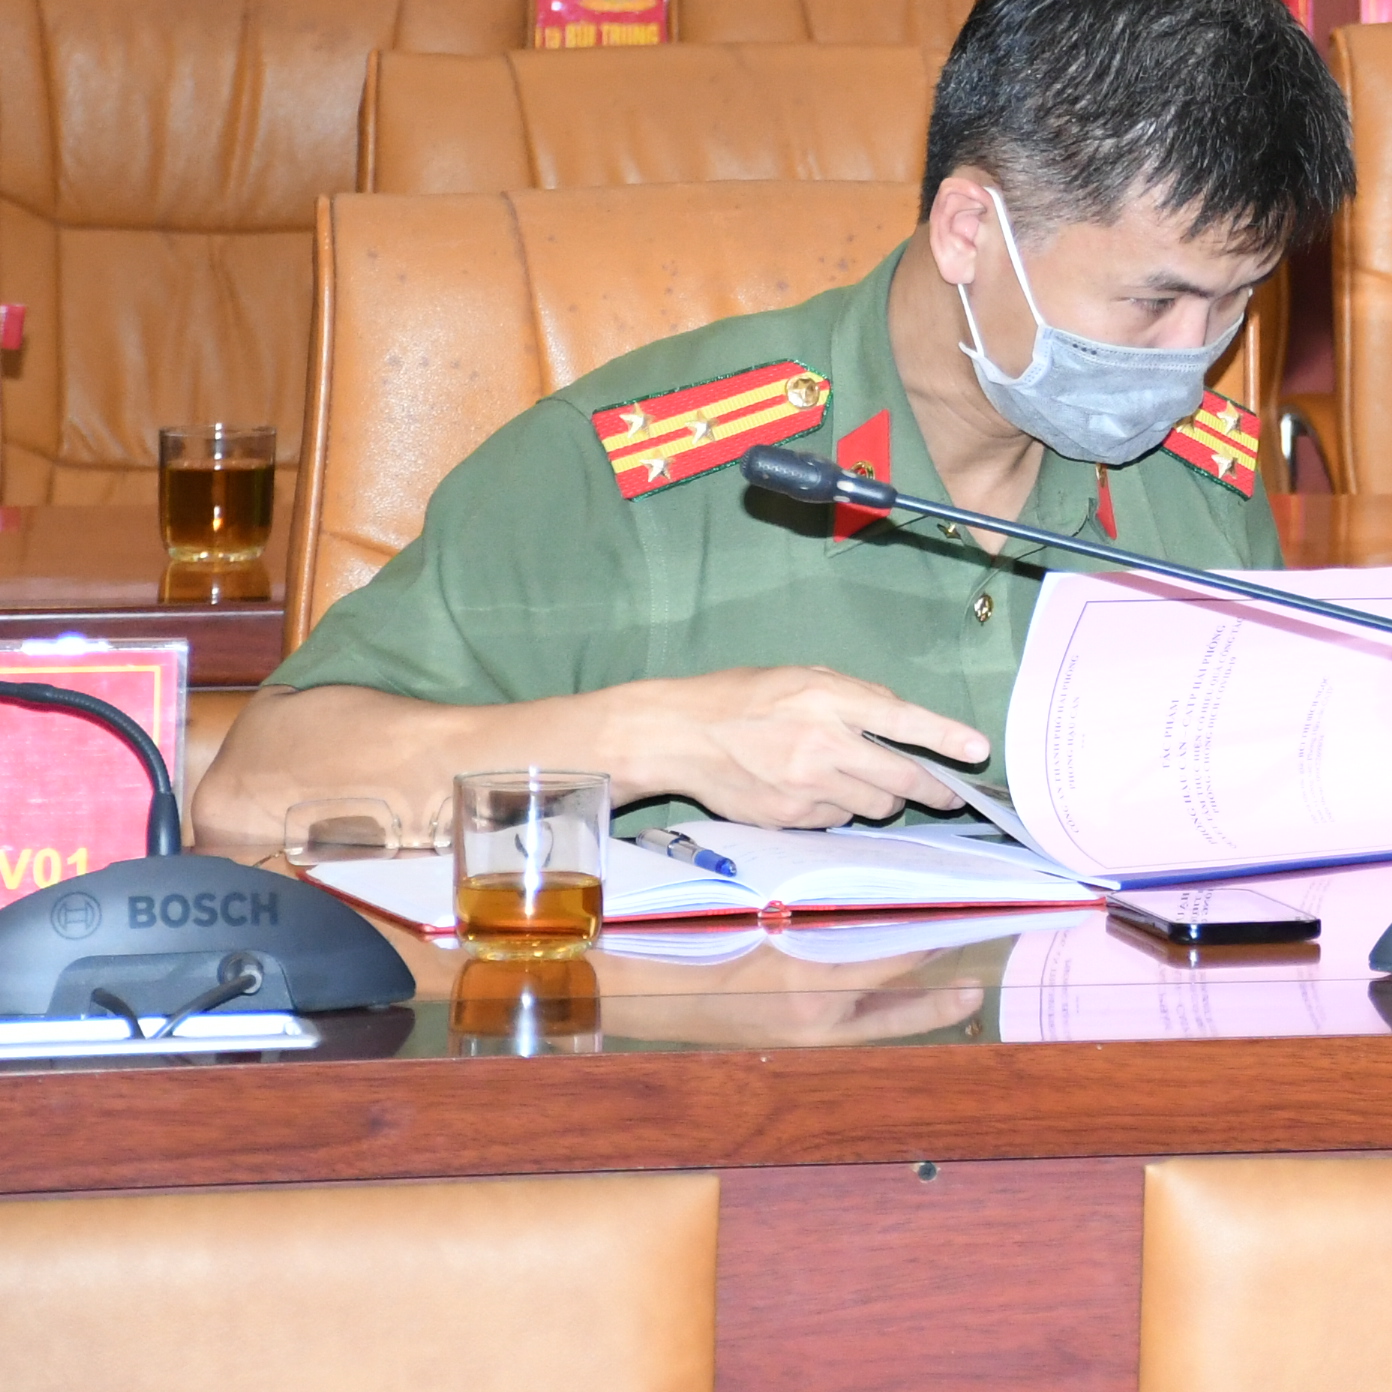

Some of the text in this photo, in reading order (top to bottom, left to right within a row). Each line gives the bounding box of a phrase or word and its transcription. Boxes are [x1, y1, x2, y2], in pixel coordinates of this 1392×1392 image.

[1215, 656, 1237, 700] COVID-19
[1182, 693, 1197, 728] CATP
[127, 891, 280, 931] BOSCH
